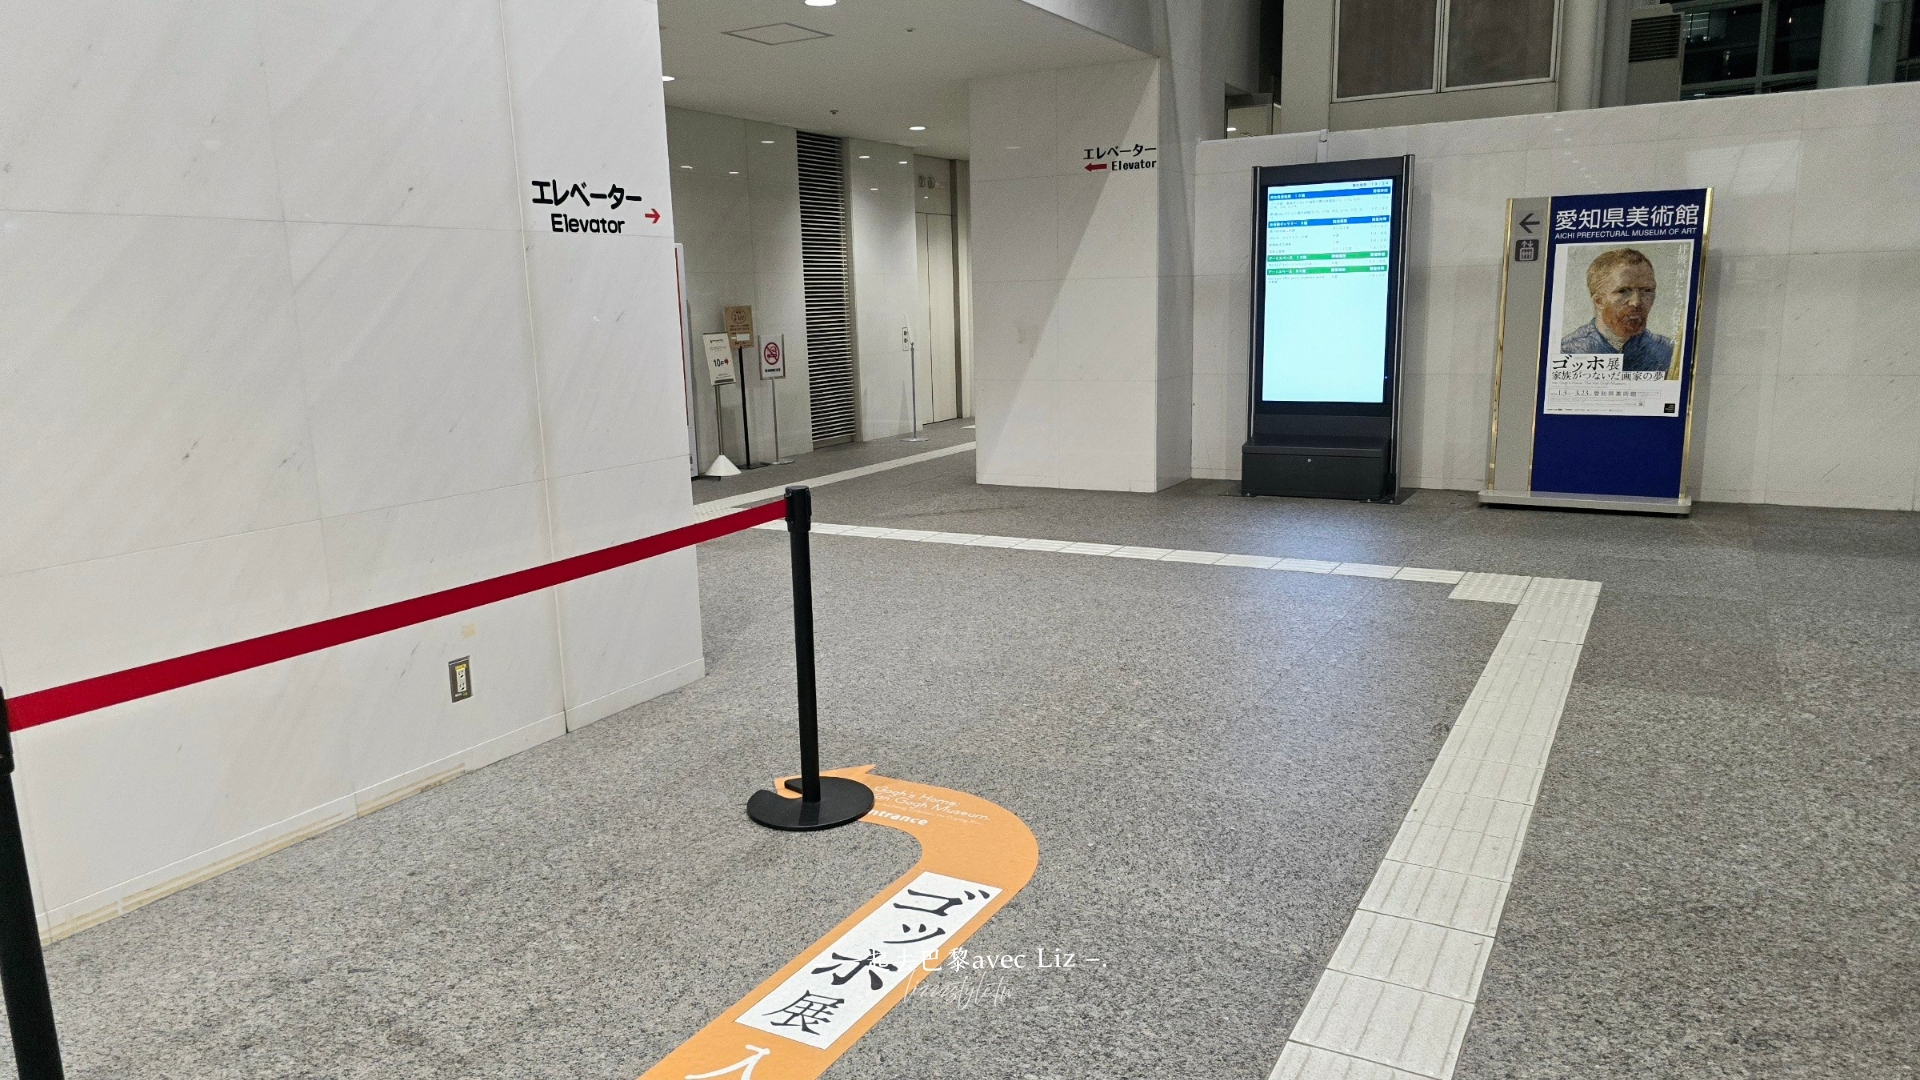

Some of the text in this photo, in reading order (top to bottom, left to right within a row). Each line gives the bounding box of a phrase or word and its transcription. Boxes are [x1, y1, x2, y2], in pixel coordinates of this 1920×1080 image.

[1083, 144, 1157, 159] エレベーター
[1111, 160, 1157, 171] Elevator
[531, 179, 642, 210] エレベーター
[551, 213, 625, 234] Elevator
[1555, 204, 1700, 231] 愛知県美術館
[1555, 227, 1698, 240] AICHI PREFECTURAL MUSEUM OF ART
[1552, 355, 1620, 373] ゴッホ展
[1552, 371, 1664, 381] 家族がつないだ画家の夢
[874, 785, 916, 799] Gogh's
[895, 797, 928, 810] Gogh
[868, 809, 929, 826] ntrance
[761, 887, 991, 1037] ゴッホ展
